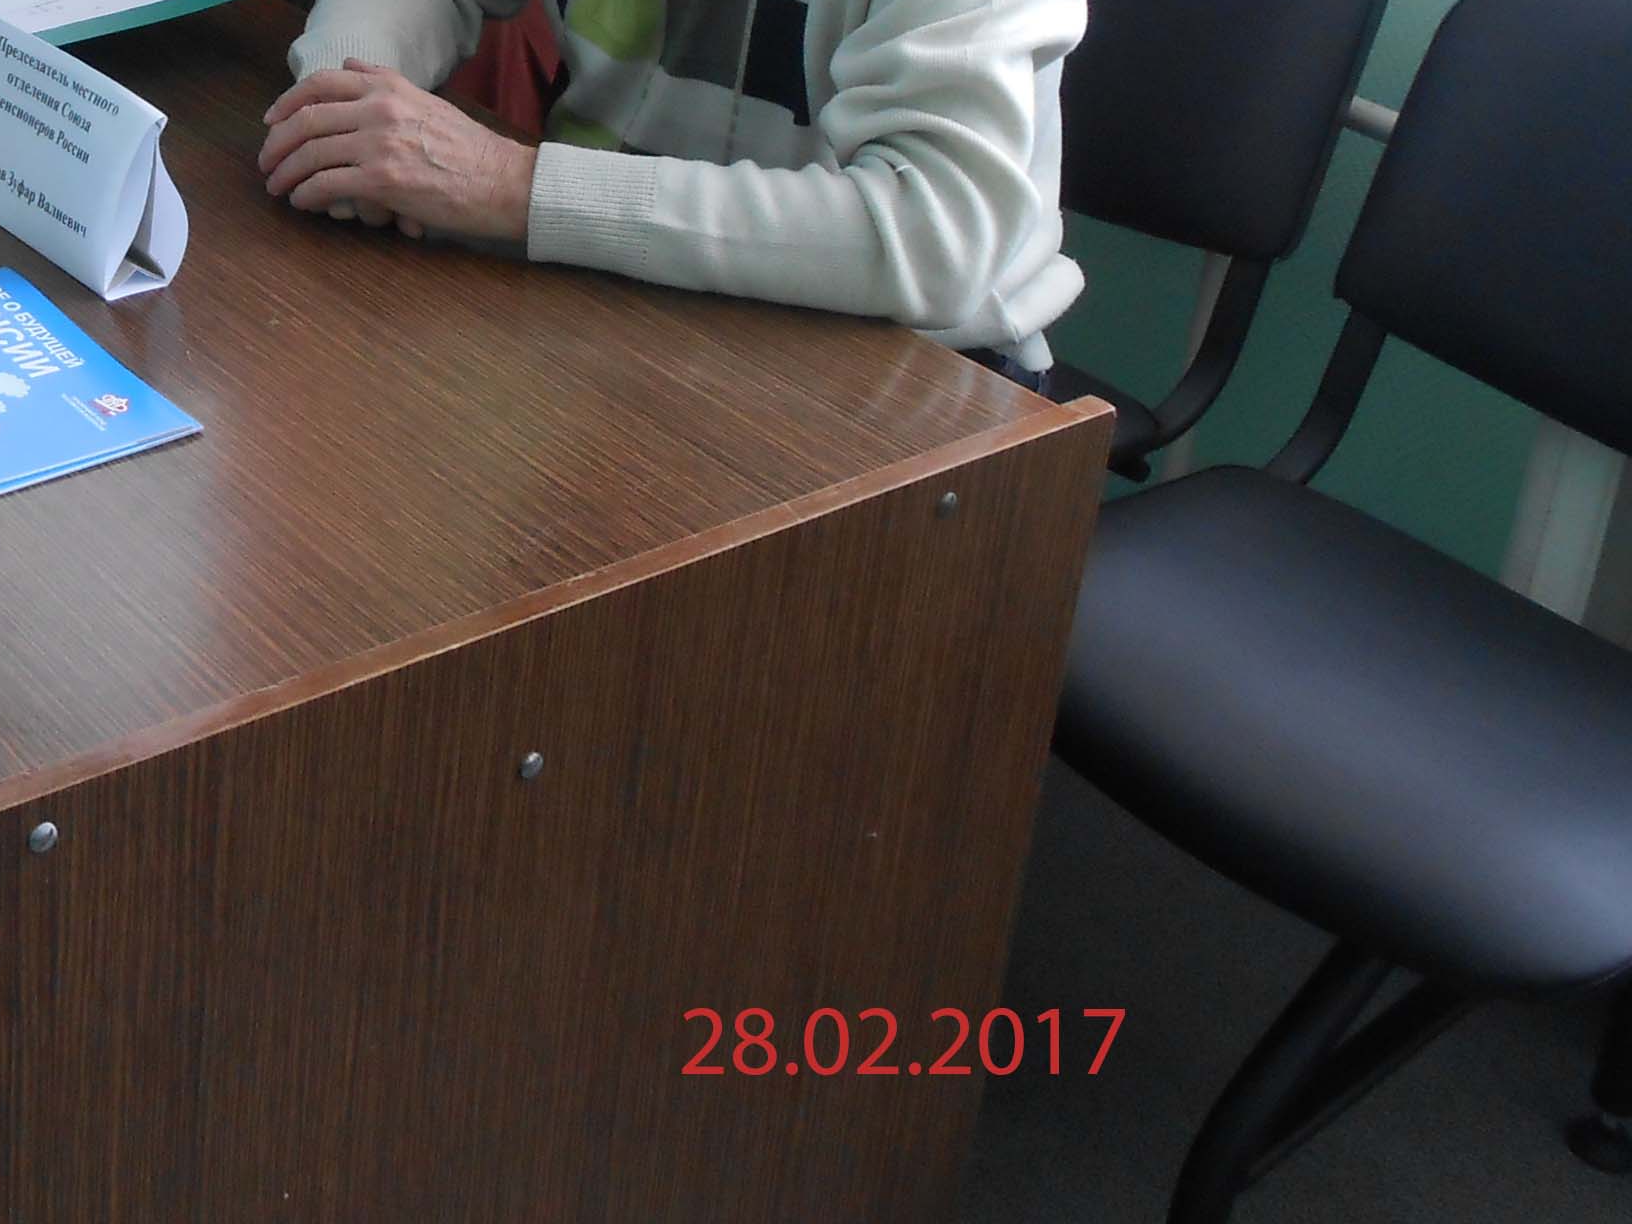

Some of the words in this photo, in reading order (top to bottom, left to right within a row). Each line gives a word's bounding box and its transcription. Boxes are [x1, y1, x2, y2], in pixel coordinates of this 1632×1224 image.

[5, 71, 61, 112] отделения
[60, 101, 92, 134] Союза
[70, 77, 120, 117] местного
[56, 130, 91, 165] России
[6, 169, 37, 207] Зуфар
[36, 191, 88, 239] Валиевич
[3, 301, 22, 314] О
[13, 311, 86, 369] БУДУЩЕЙ
